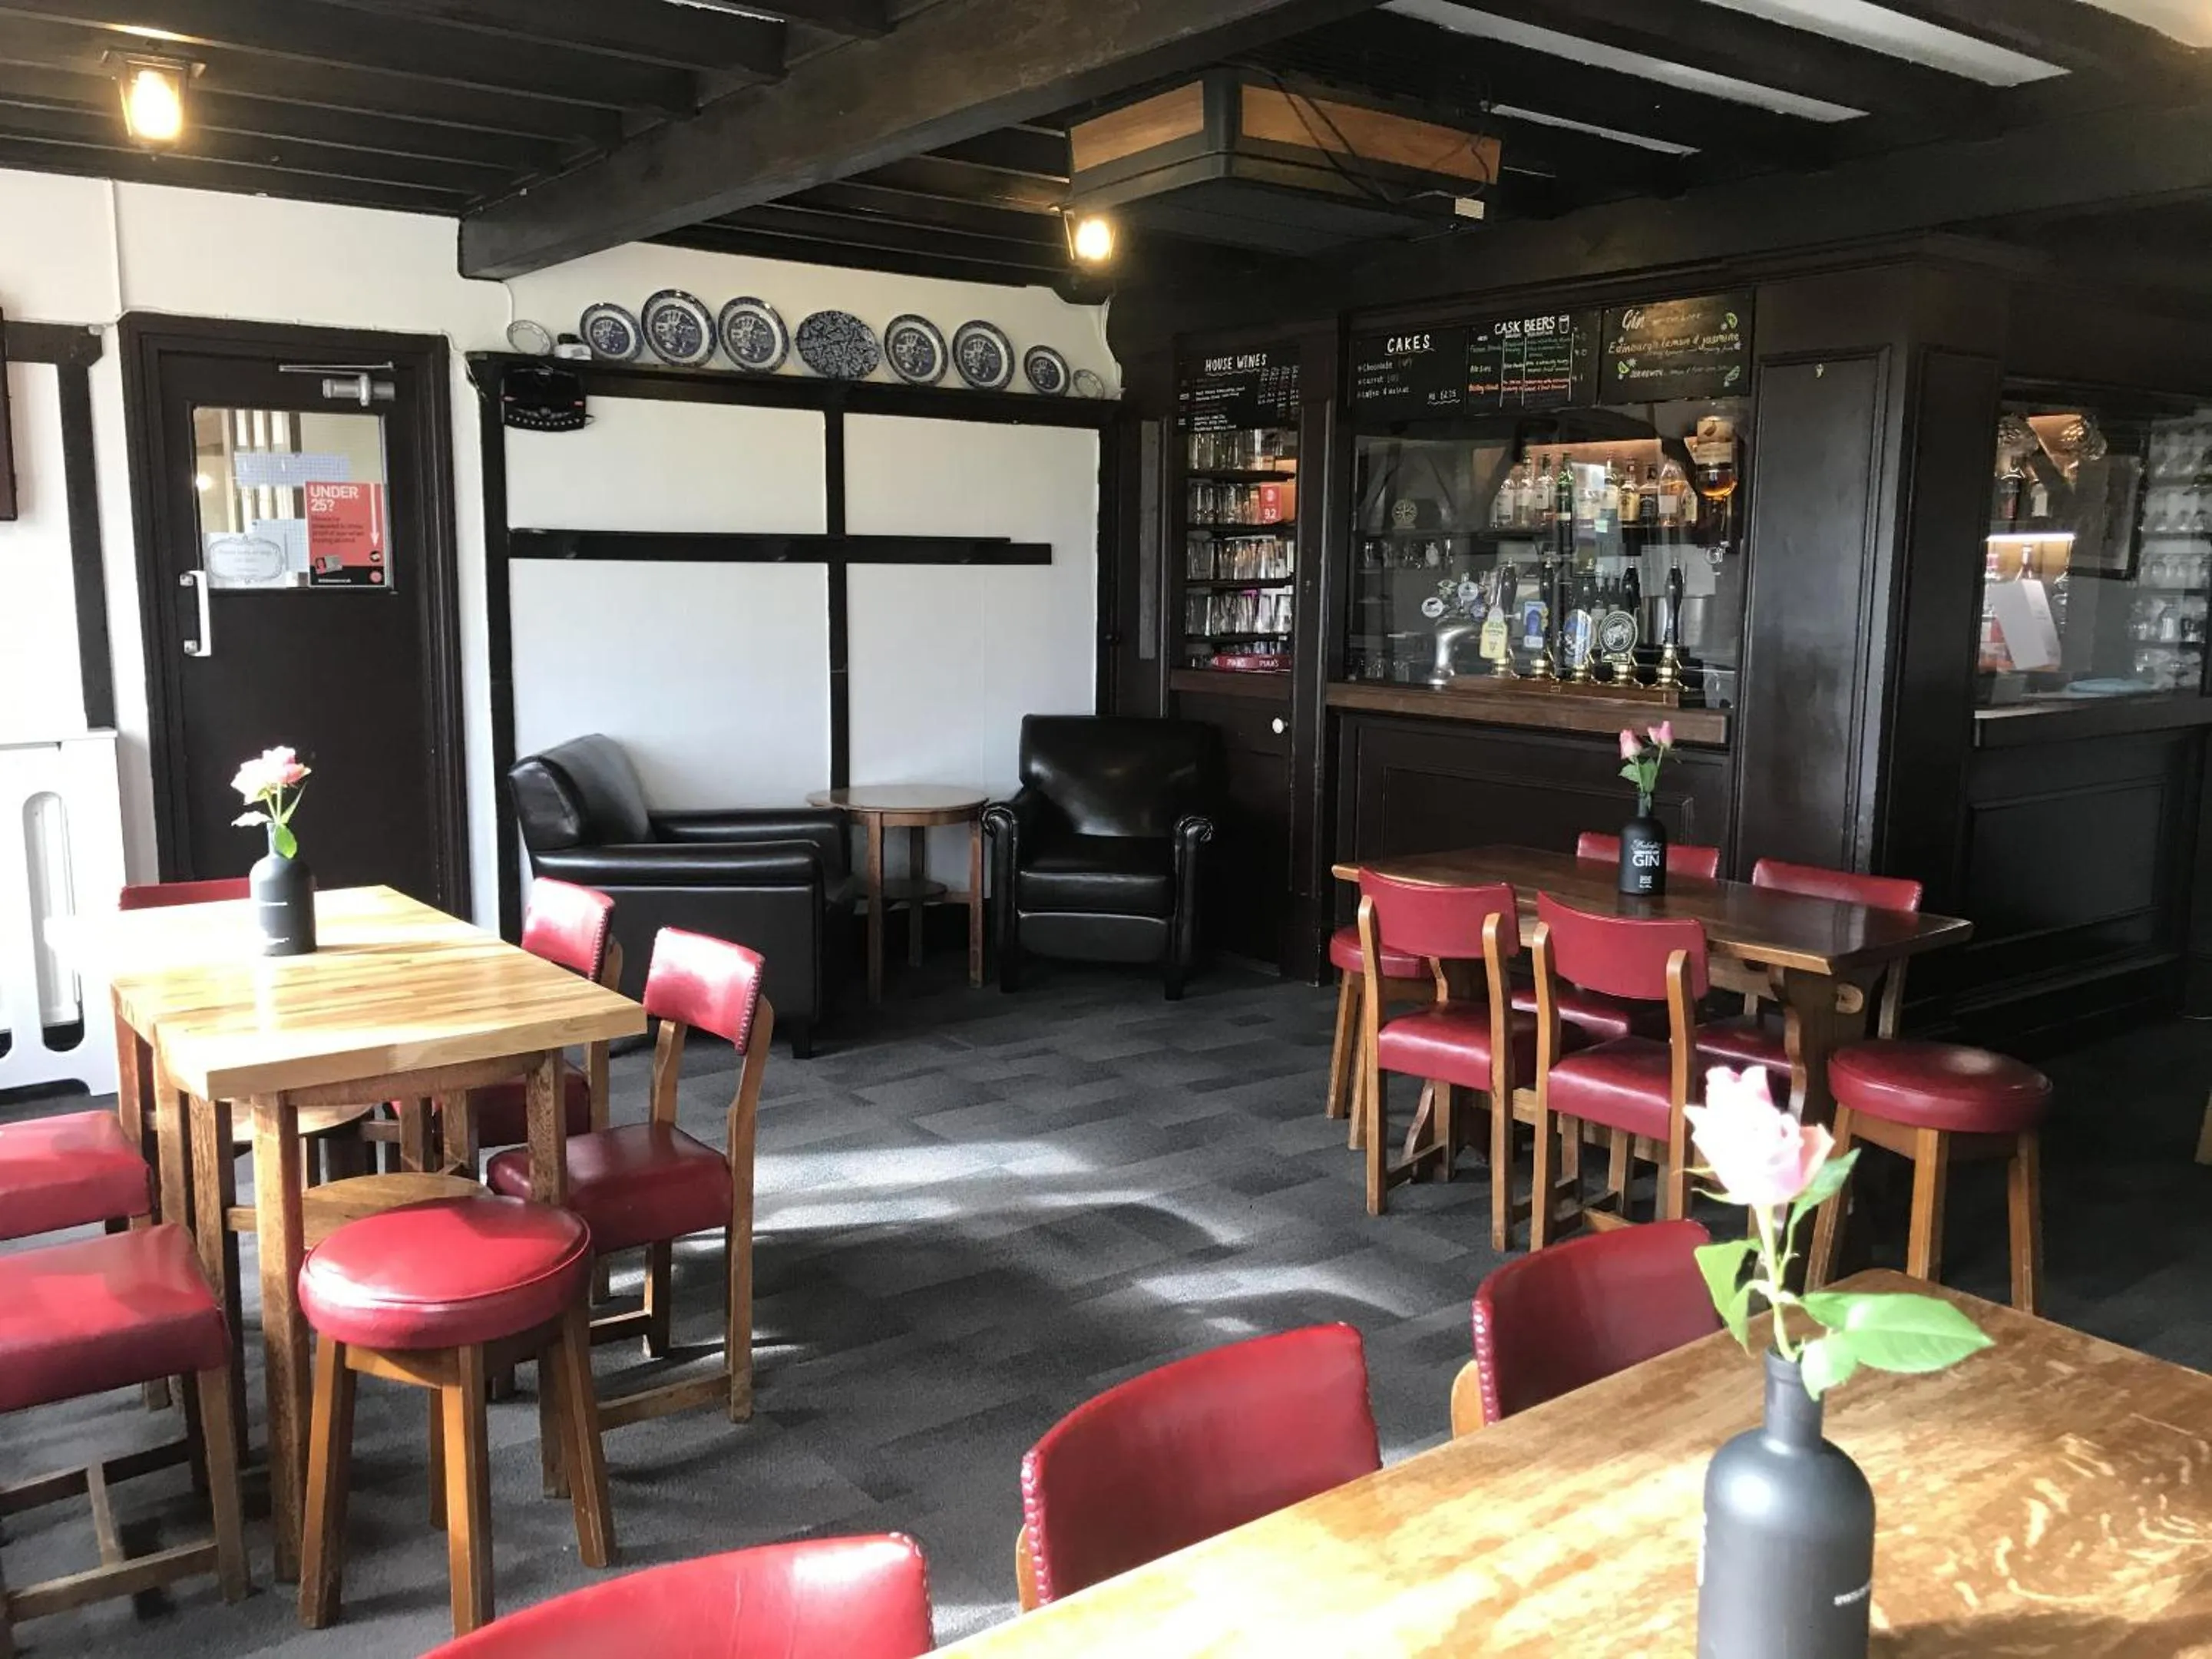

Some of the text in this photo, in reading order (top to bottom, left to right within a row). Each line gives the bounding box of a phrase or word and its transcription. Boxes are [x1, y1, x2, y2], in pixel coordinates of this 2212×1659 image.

[1494, 321, 1521, 335] CASK
[1524, 316, 1556, 333] BEERS
[1622, 309, 1645, 331] Gin
[1387, 334, 1430, 353] CAKES
[1205, 353, 1268, 372] HOUSE WINES
[309, 484, 359, 498] UNDER
[311, 498, 335, 512] 25?
[1632, 854, 1660, 867] GIN
